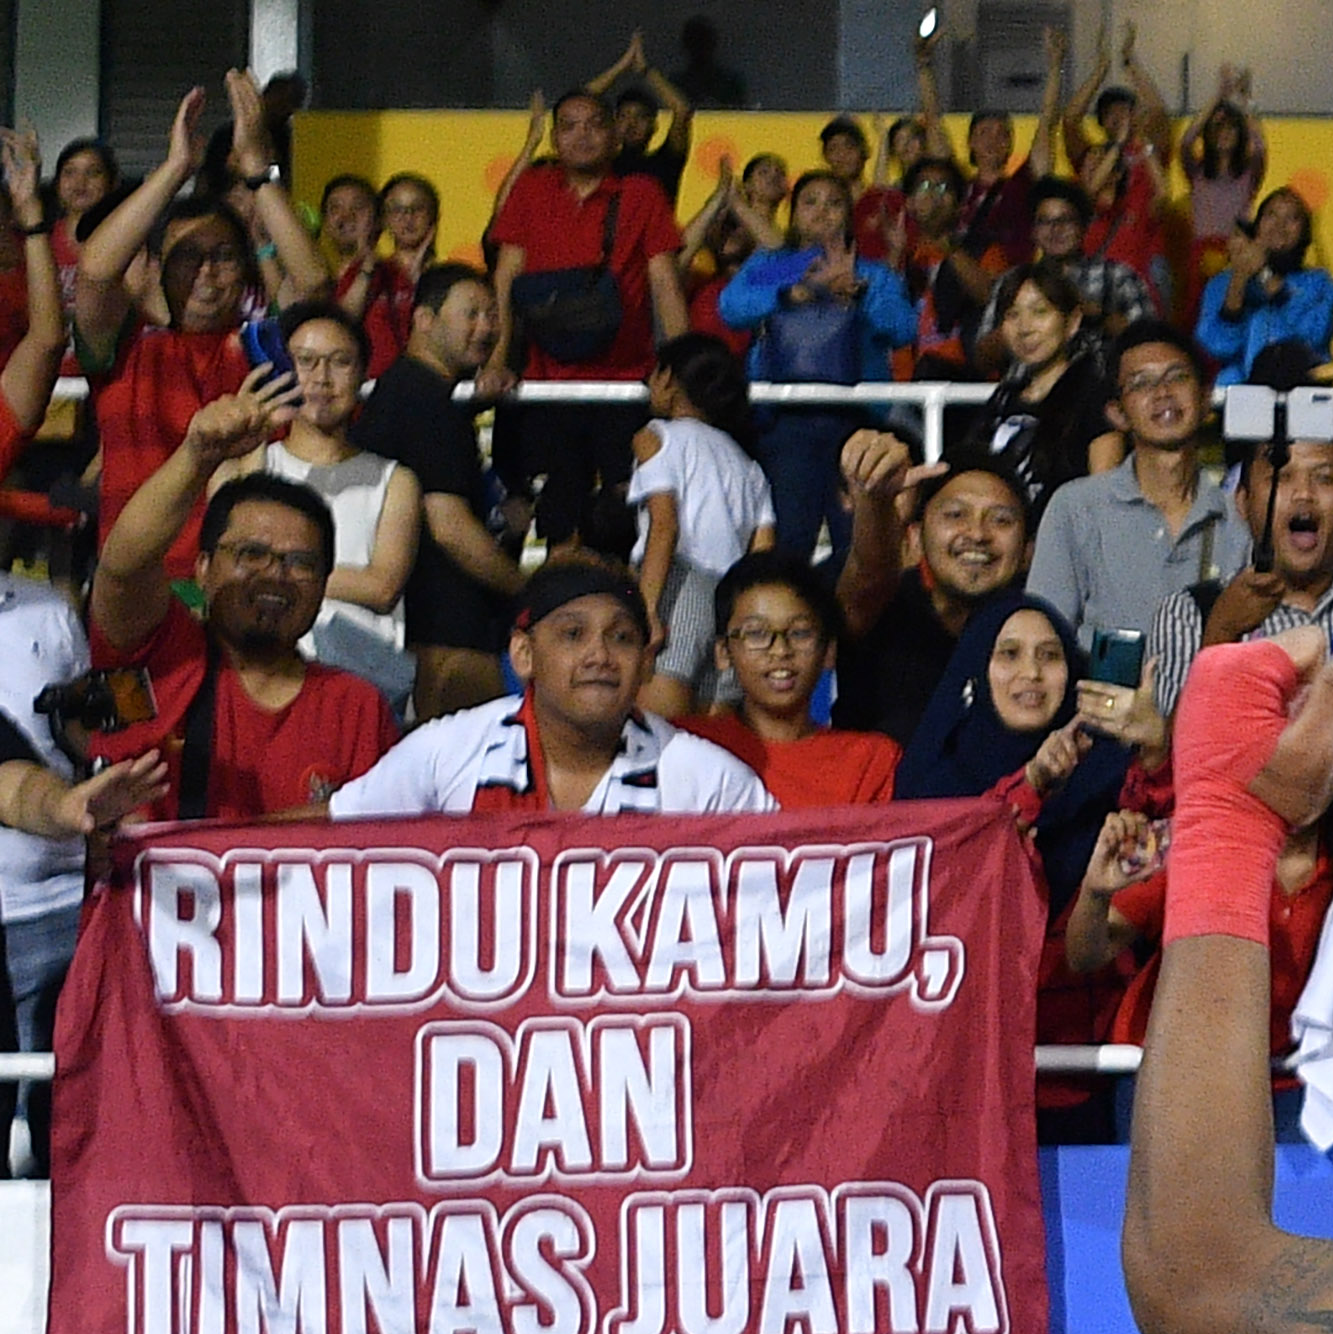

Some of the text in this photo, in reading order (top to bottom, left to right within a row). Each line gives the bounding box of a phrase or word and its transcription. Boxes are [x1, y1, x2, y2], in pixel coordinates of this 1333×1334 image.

[136, 836, 964, 1014] RINDU KAMU,
[415, 1013, 691, 1190] DAN
